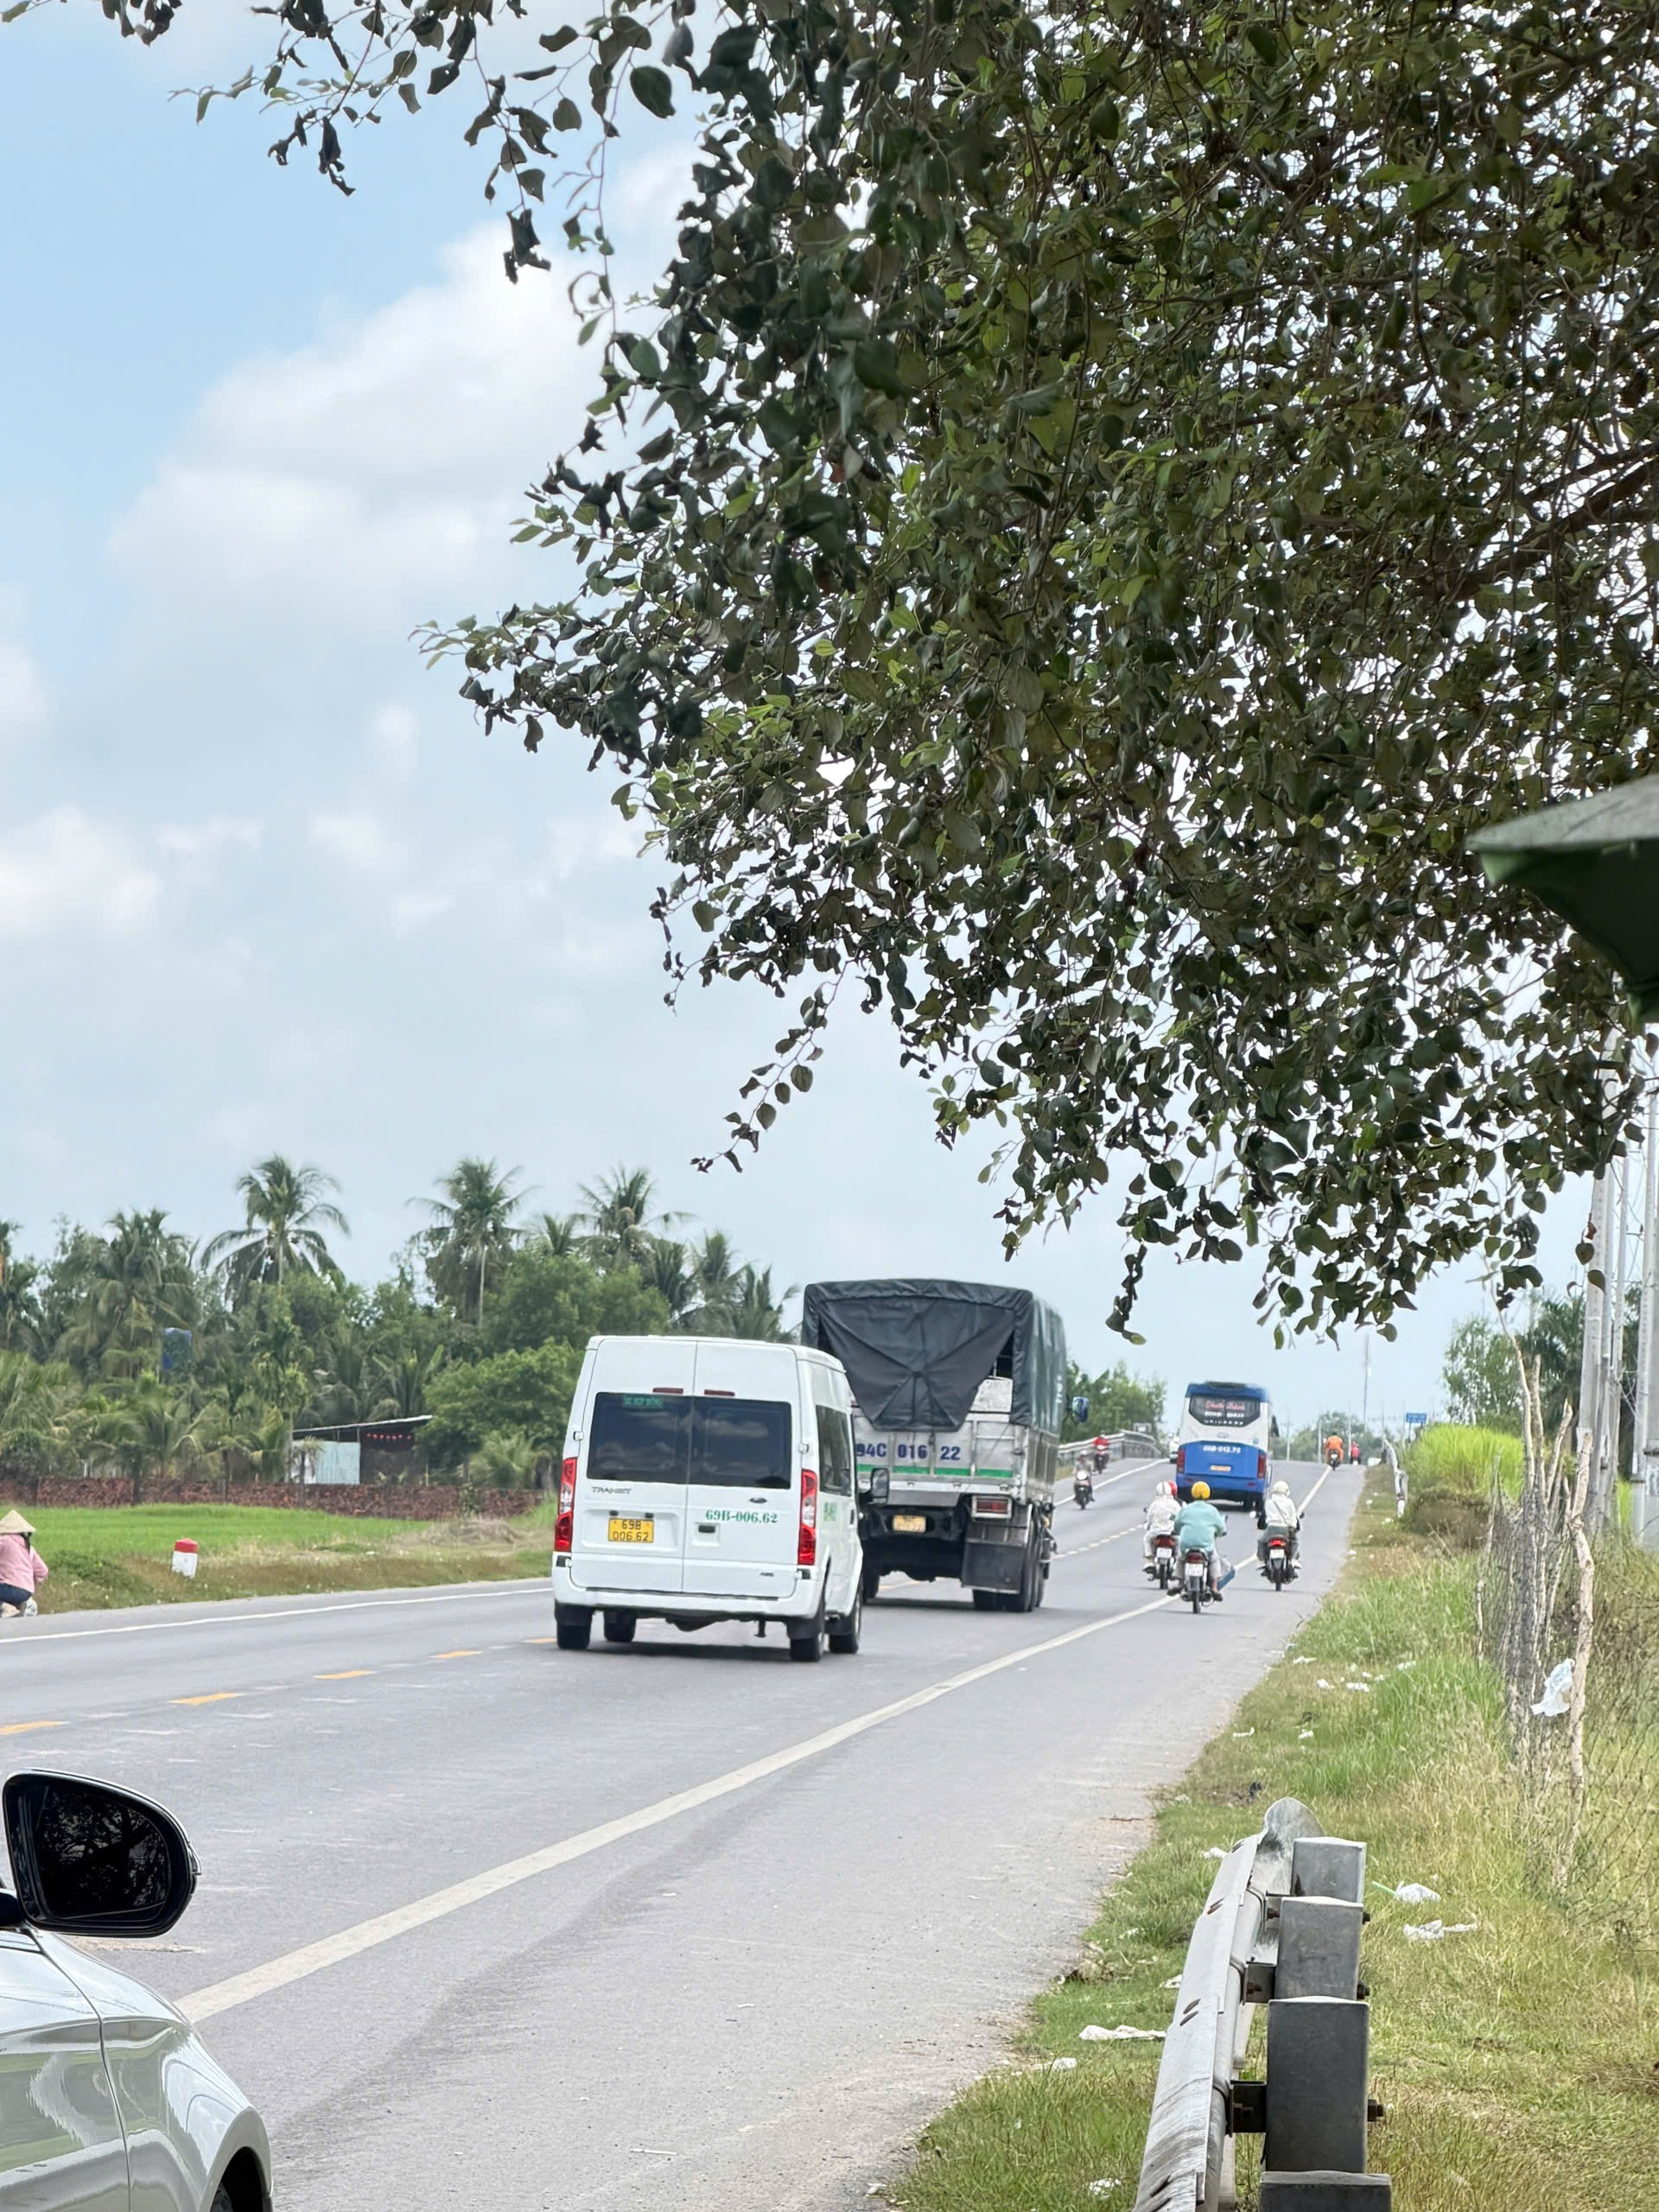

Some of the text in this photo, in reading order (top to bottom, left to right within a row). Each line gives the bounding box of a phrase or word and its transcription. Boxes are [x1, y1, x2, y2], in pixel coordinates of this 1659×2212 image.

[855, 1443, 961, 1460] 94C 016 22
[705, 1509, 778, 1523] 69B-006.62
[622, 1519, 641, 1530] 69B
[613, 1531, 649, 1541] 006.62
